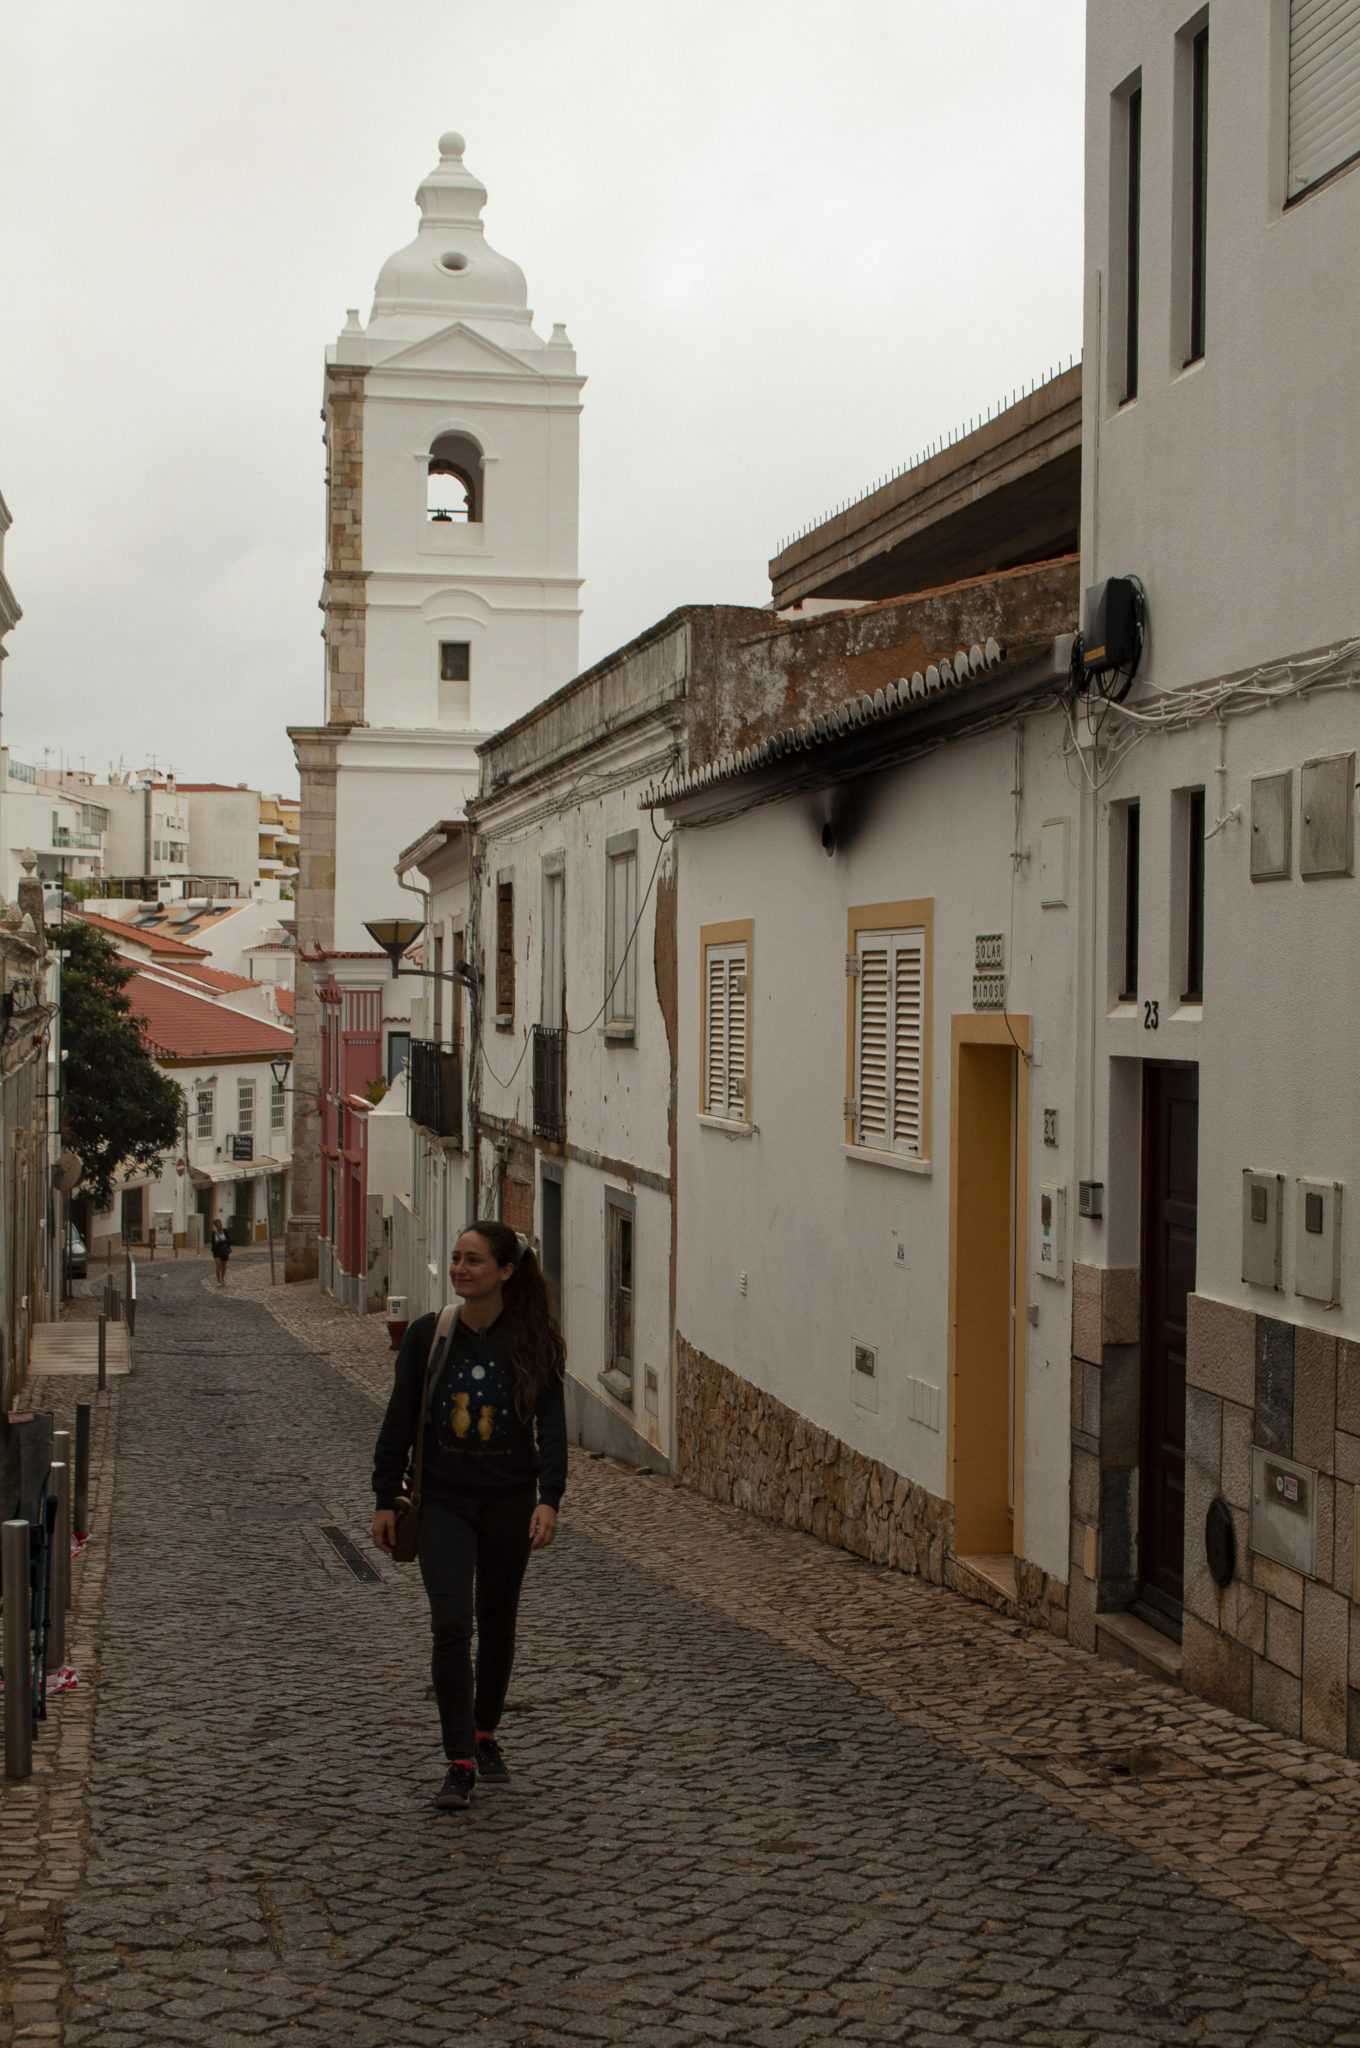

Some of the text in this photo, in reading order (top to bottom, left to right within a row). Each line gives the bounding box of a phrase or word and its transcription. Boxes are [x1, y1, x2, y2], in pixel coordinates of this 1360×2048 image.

[976, 944, 1001, 959] SOLAR
[973, 984, 1004, 998] MIMOSO
[1144, 1000, 1159, 1030] 23
[1044, 1120, 1055, 1135] 21
